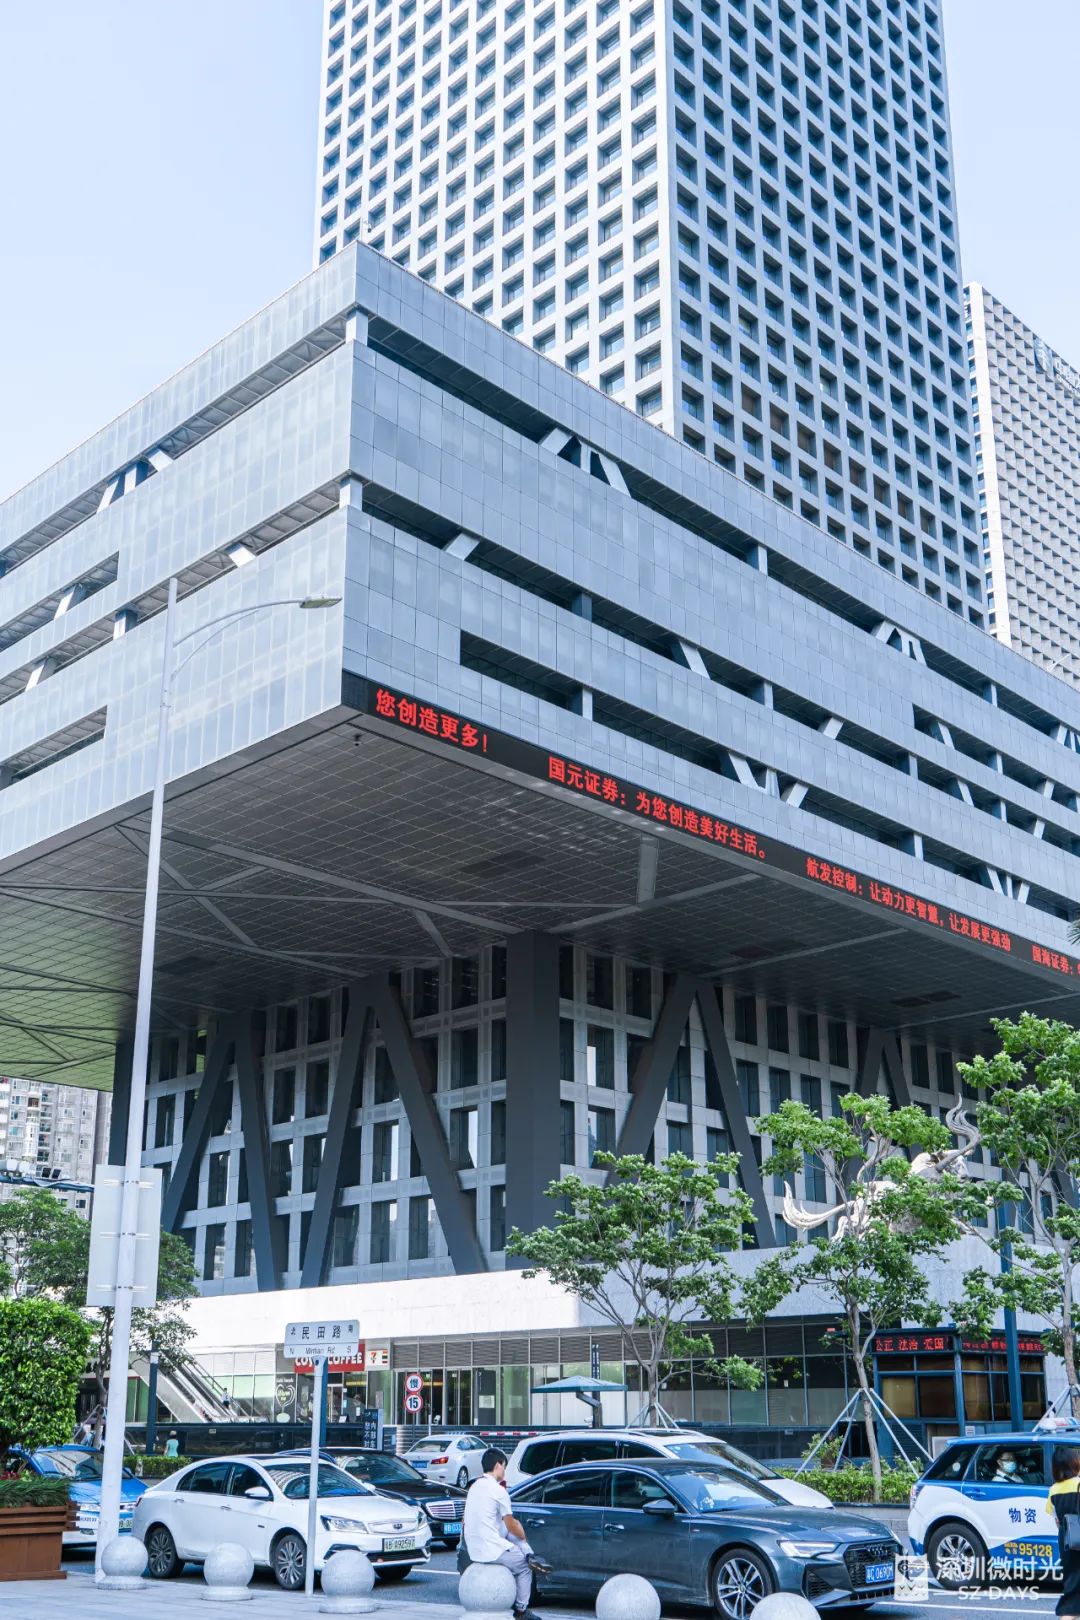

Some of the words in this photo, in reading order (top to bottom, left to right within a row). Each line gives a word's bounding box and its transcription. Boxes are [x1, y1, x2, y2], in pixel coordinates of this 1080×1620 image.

[301, 1325, 341, 1340] 民田路
[409, 1397, 418, 1408] 15
[1008, 1508, 1037, 1523] 物资
[1019, 1543, 1052, 1557] 95128
